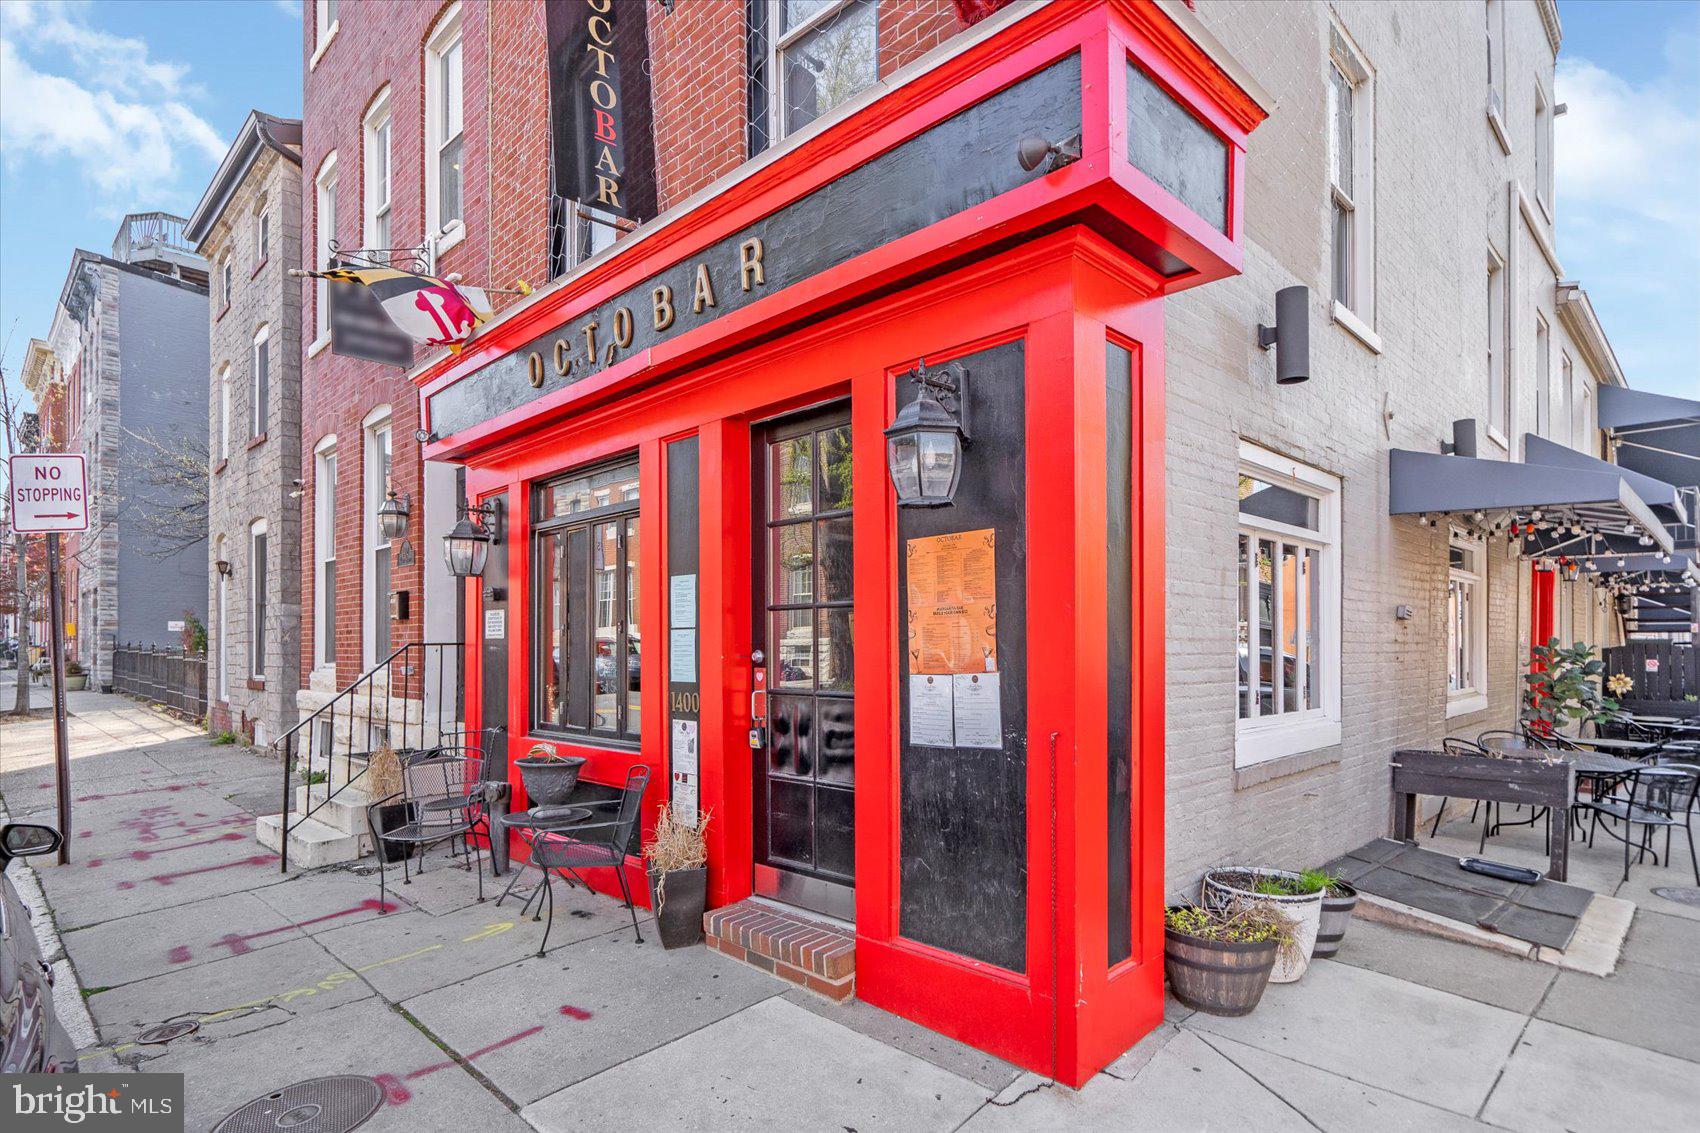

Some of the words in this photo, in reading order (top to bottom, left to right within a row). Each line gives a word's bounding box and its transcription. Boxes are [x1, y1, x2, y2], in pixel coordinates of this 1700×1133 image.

[528, 236, 765, 389] OCTOBAR
[34, 466, 61, 480] NO
[17, 487, 81, 502] STOPPING
[670, 691, 700, 713] 1400
